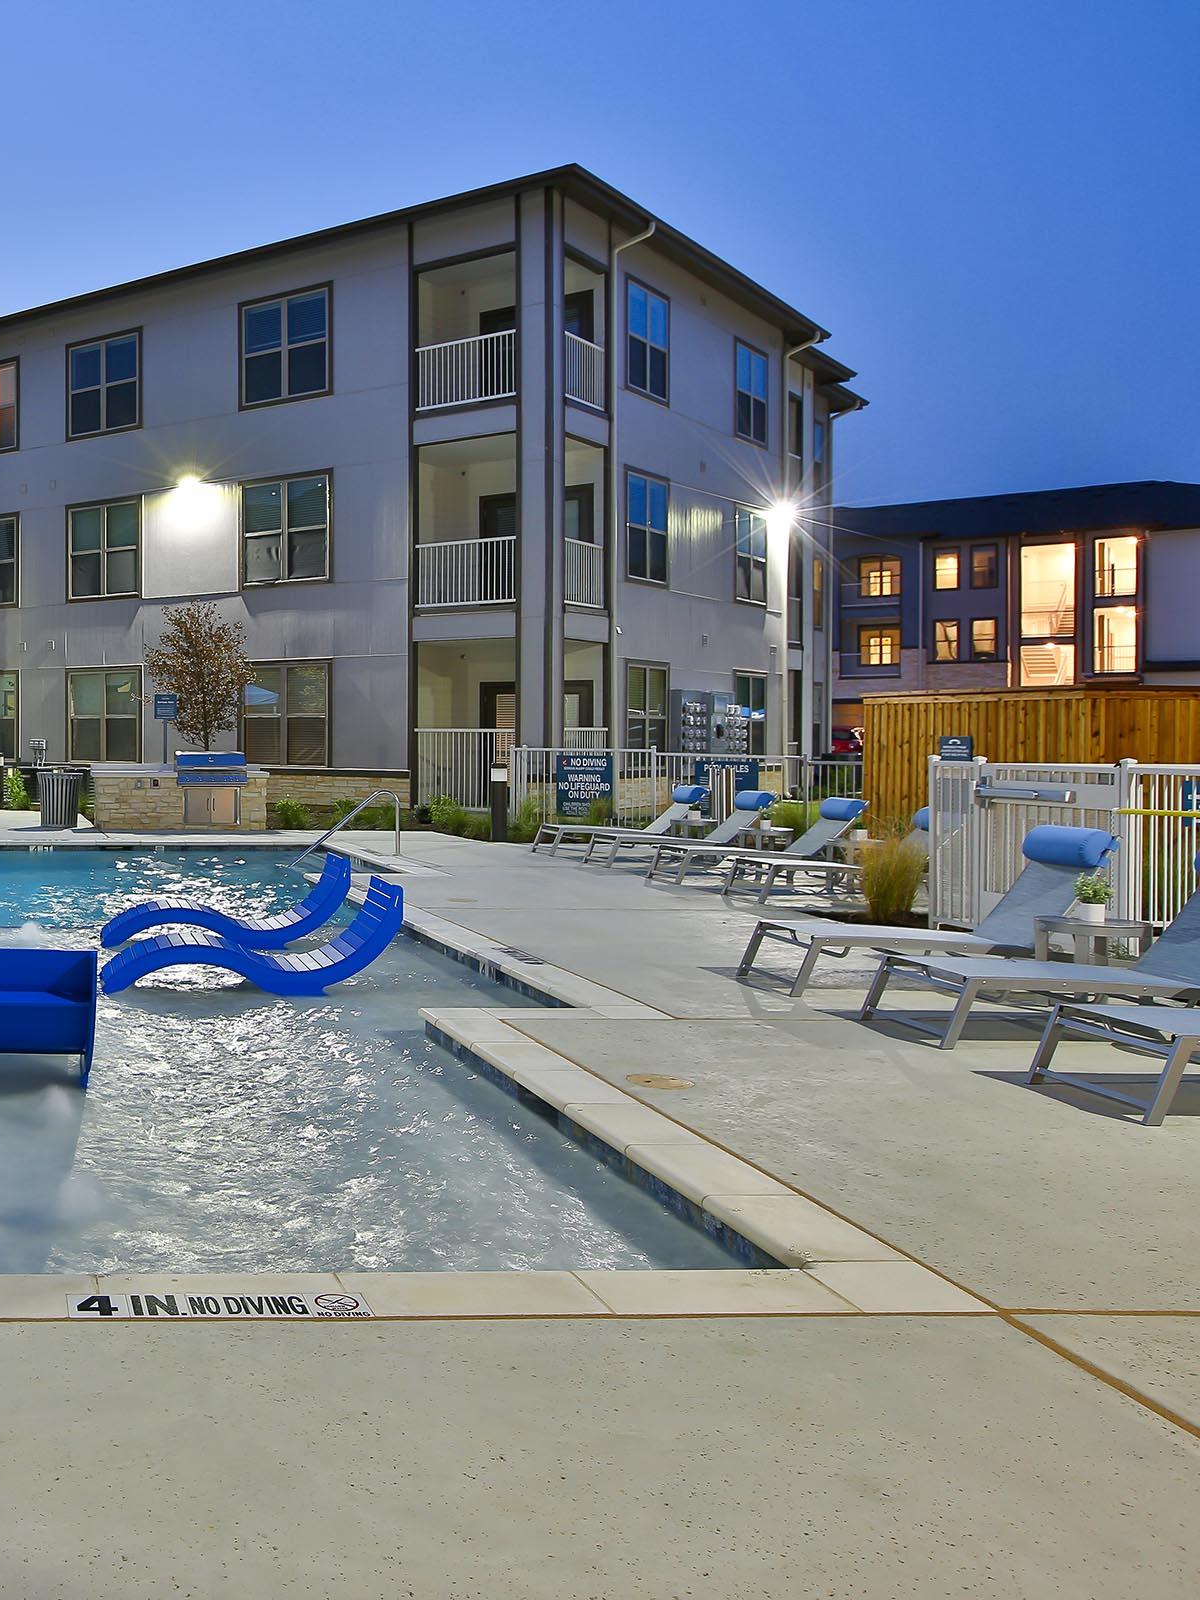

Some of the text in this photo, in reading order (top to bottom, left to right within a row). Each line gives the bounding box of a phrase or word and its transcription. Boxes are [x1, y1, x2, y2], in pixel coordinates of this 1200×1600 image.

[570, 758, 607, 767] NO DIVING
[567, 774, 601, 782] WARNING
[558, 782, 611, 791] NO LIFEGUARD
[568, 791, 600, 799] ON DUTY
[77, 1295, 310, 1316] 4 IN. NO DIVING
